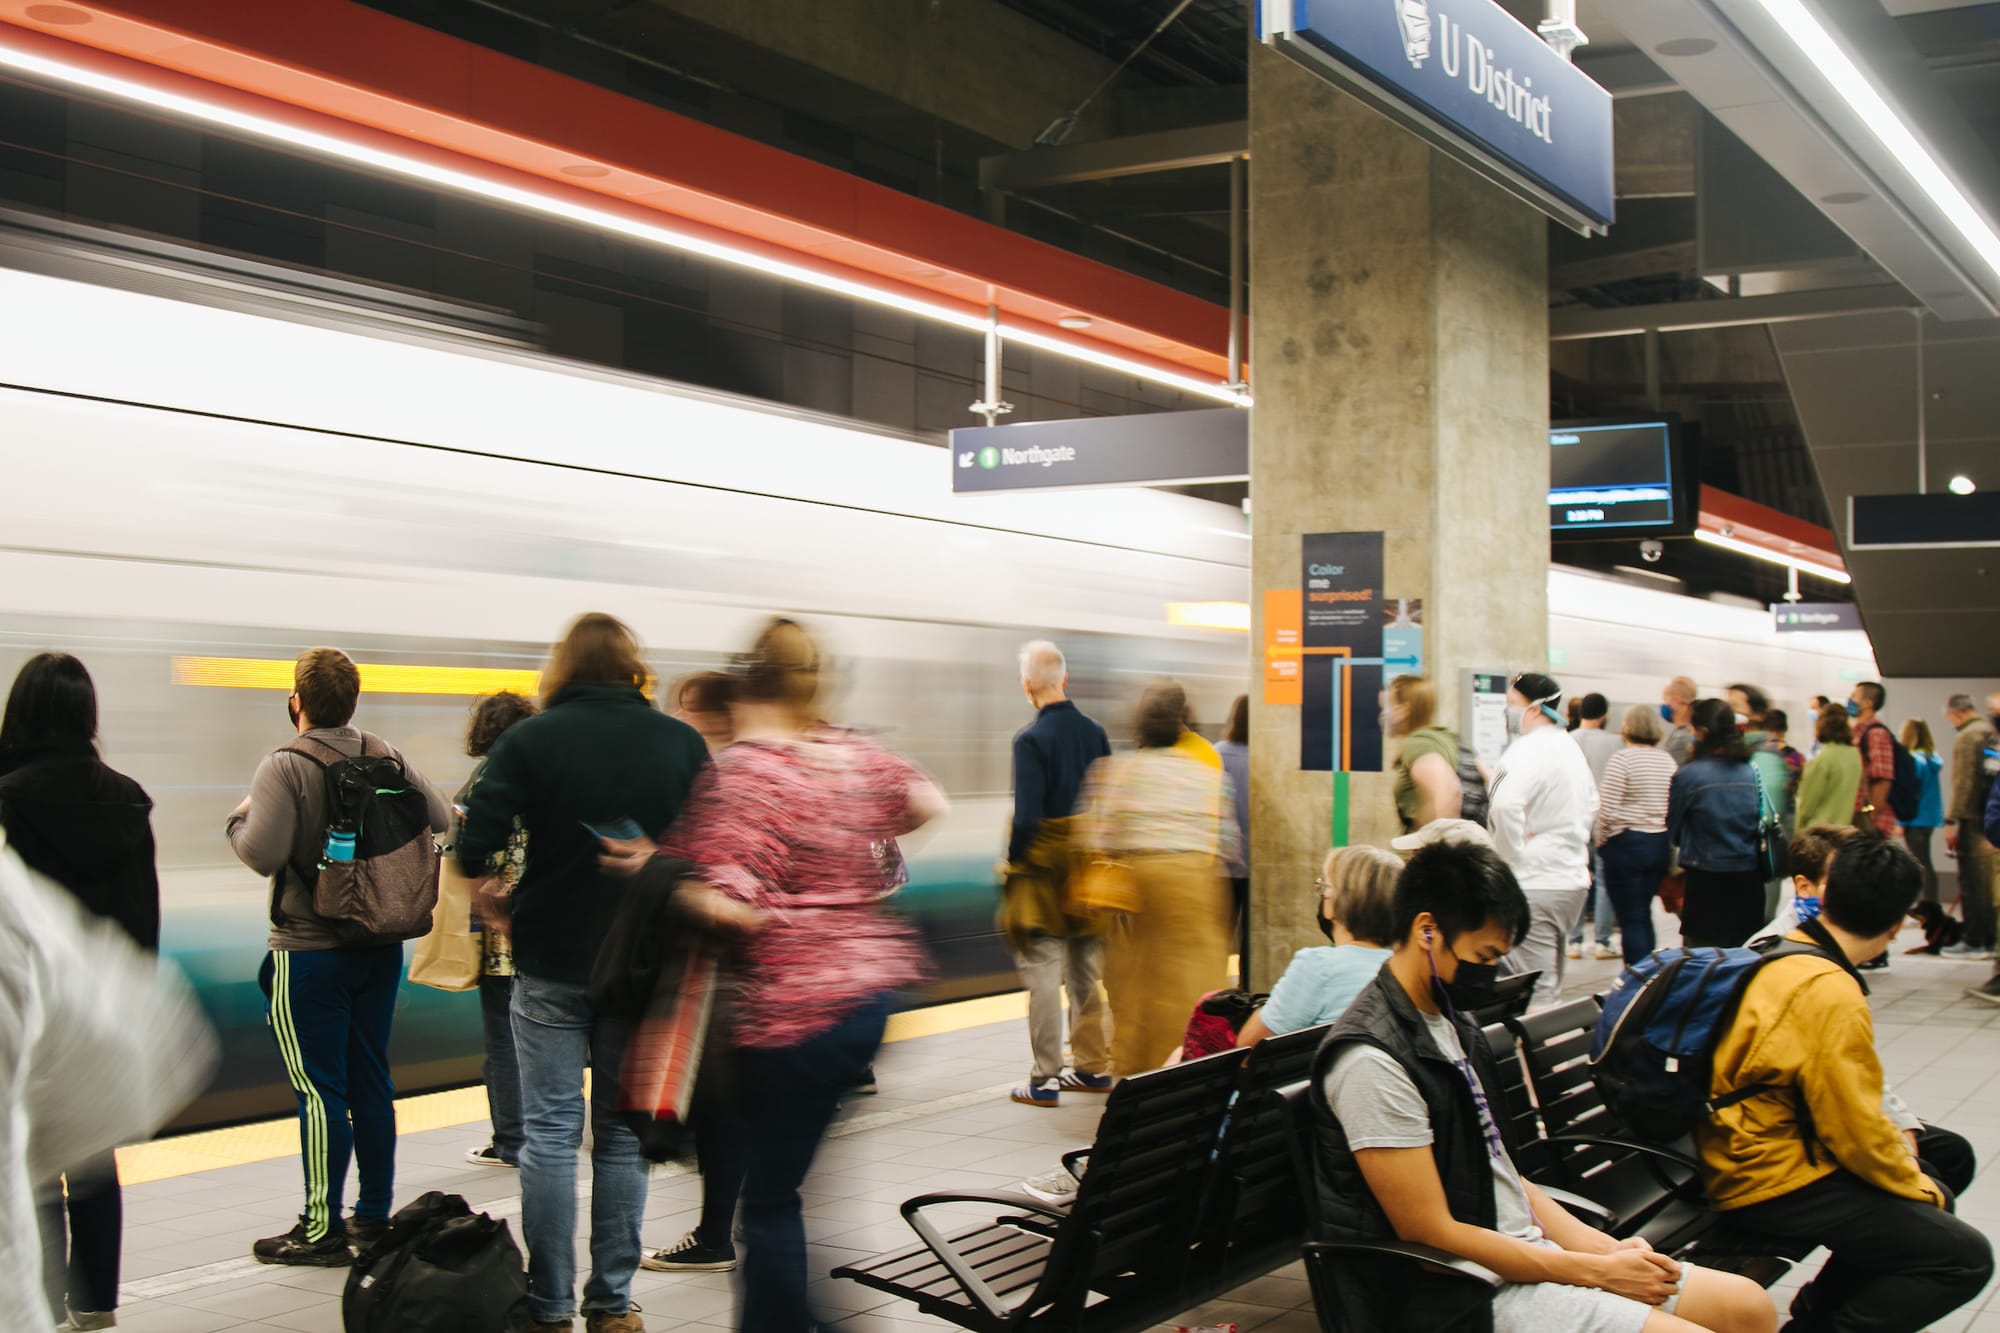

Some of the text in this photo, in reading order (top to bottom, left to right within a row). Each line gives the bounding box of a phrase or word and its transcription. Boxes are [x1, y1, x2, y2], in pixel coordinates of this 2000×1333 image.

[1438, 13, 1552, 144] U District
[1002, 445, 1076, 467] Northgate
[1308, 564, 1344, 576] Color
[1308, 579, 1330, 589] me
